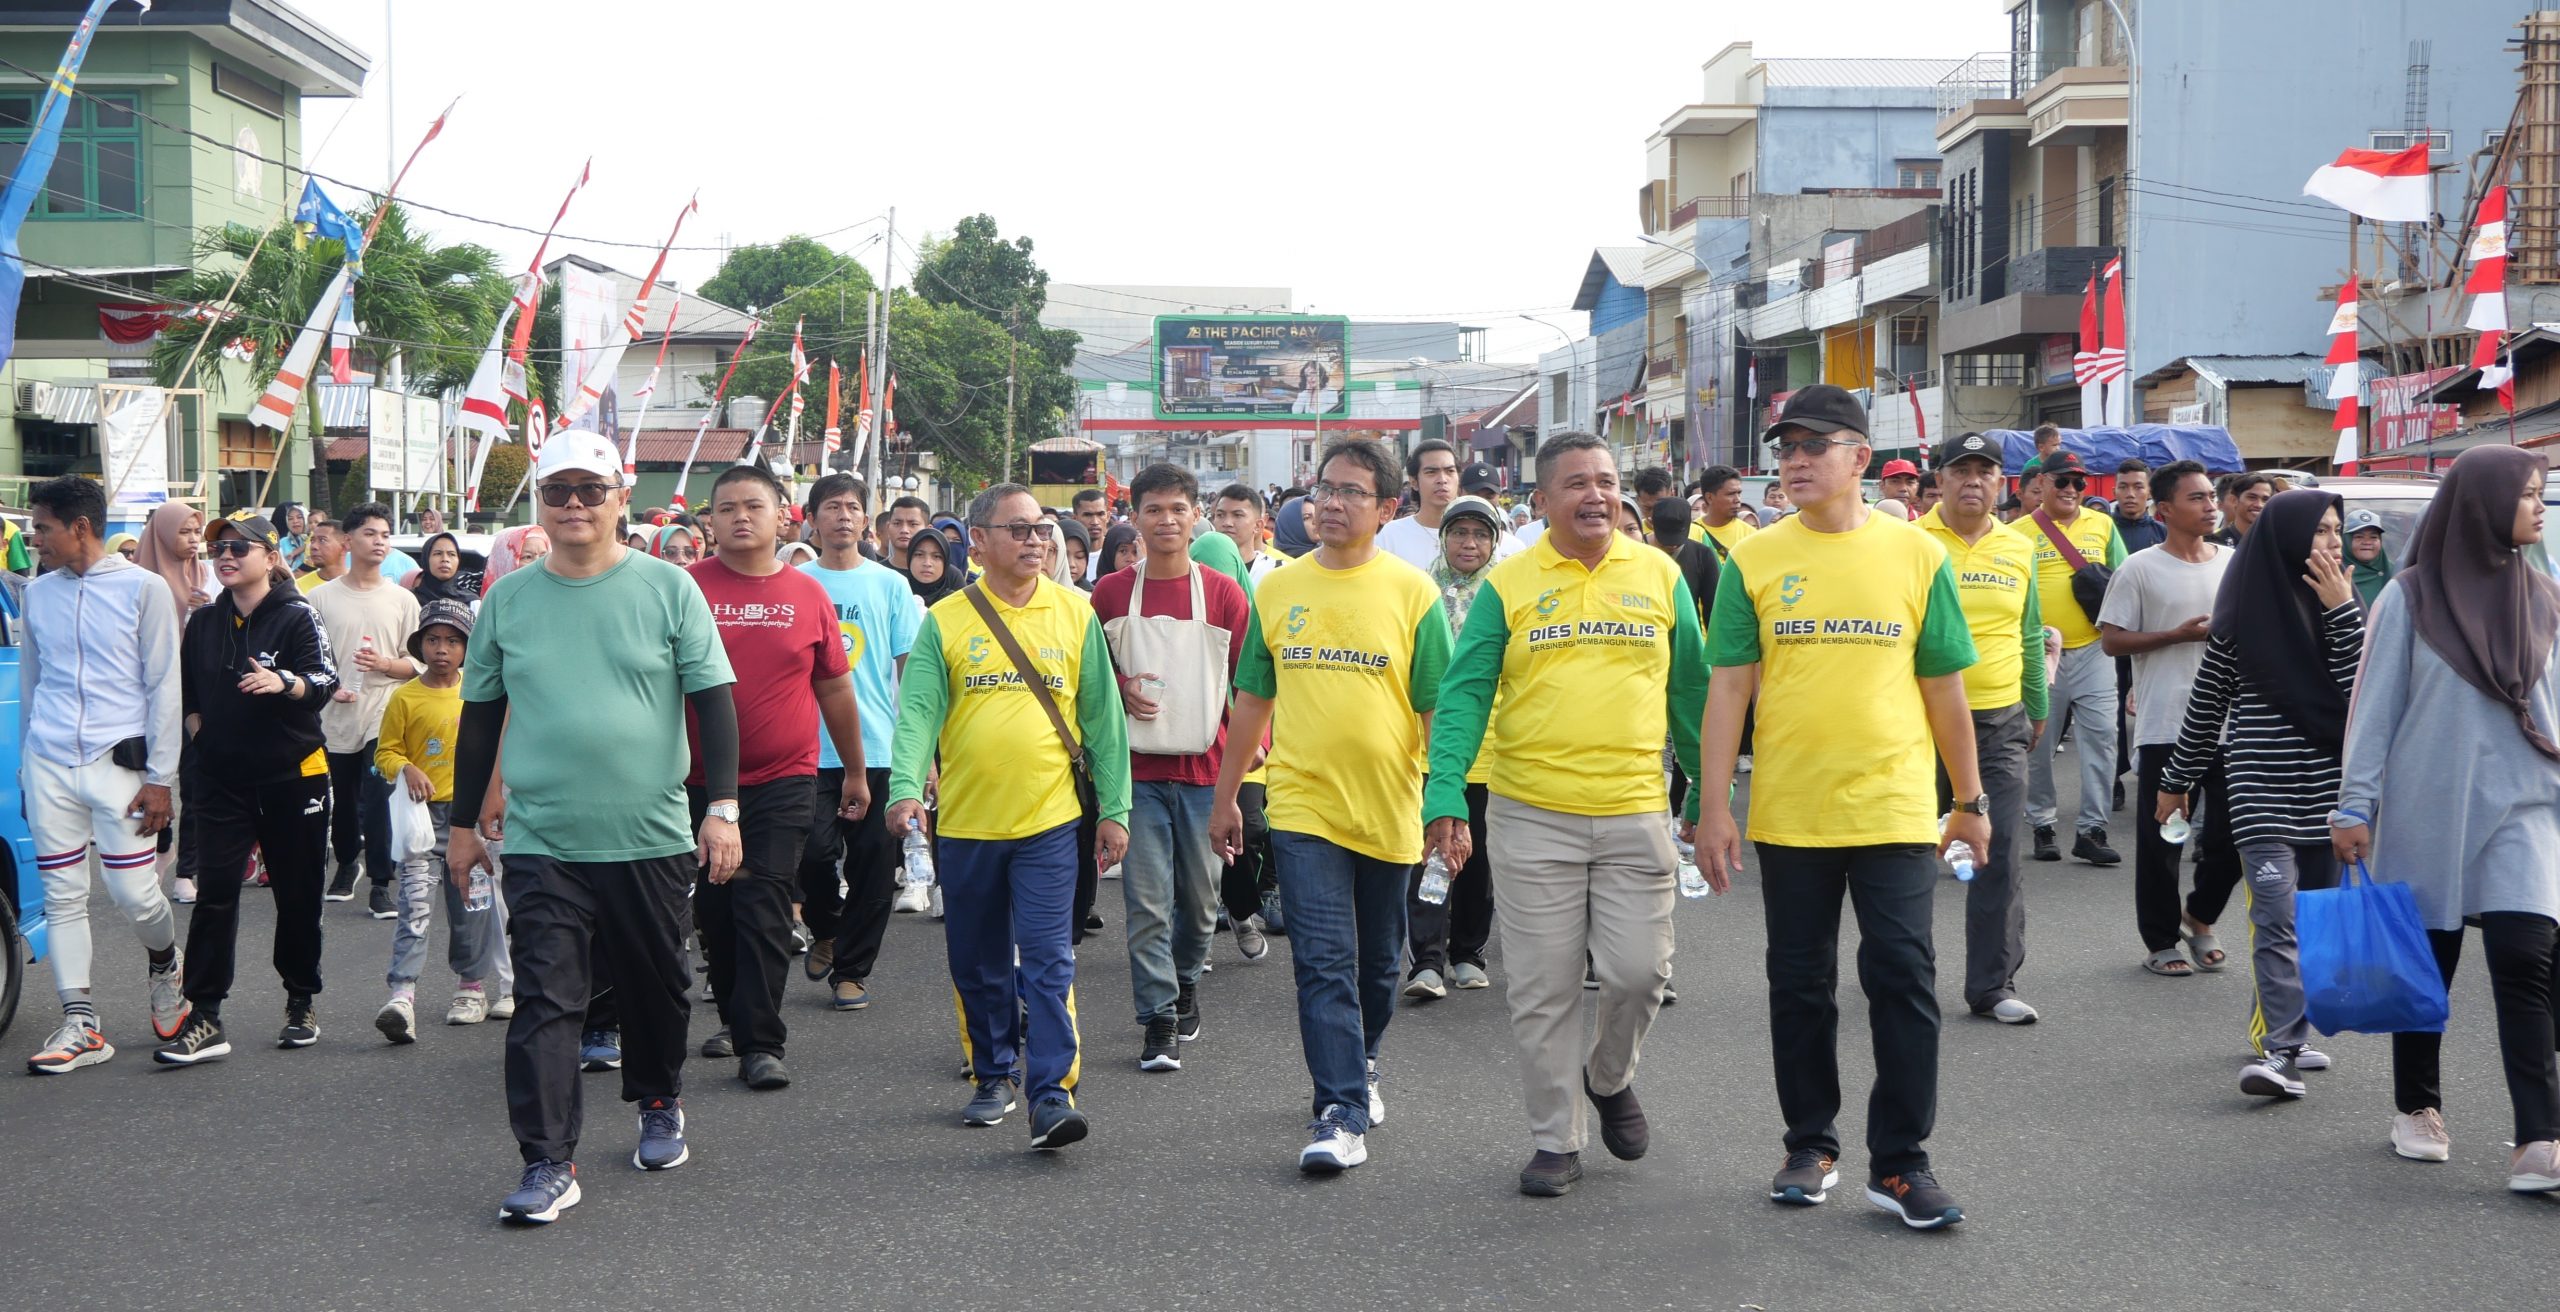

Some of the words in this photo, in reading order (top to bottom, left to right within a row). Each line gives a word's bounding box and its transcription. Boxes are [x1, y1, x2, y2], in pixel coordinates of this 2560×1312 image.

[1205, 326, 1228, 338] THE
[1232, 326, 1286, 338] PACIFIC
[1290, 326, 1318, 338] BAY
[1961, 572, 2017, 587] NATALIS
[1621, 593, 1651, 609] BNI
[1529, 624, 1571, 642] DIES
[1578, 621, 1655, 638] NATALIS
[1774, 620, 1815, 635] DIES
[1823, 619, 1903, 637] NATALIS
[1530, 640, 1576, 653] BERSINERGI
[1576, 637, 1627, 646] MEMBANGUN
[1628, 639, 1656, 648] NEGERI
[1820, 637, 1872, 645] MEMBANGUN
[1282, 646, 1312, 660] DIES
[1318, 647, 1389, 668] NATALIS
[965, 674, 999, 688] DIES
[1000, 671, 1064, 689] NALIS
[998, 685, 1032, 693] MEMBANG
